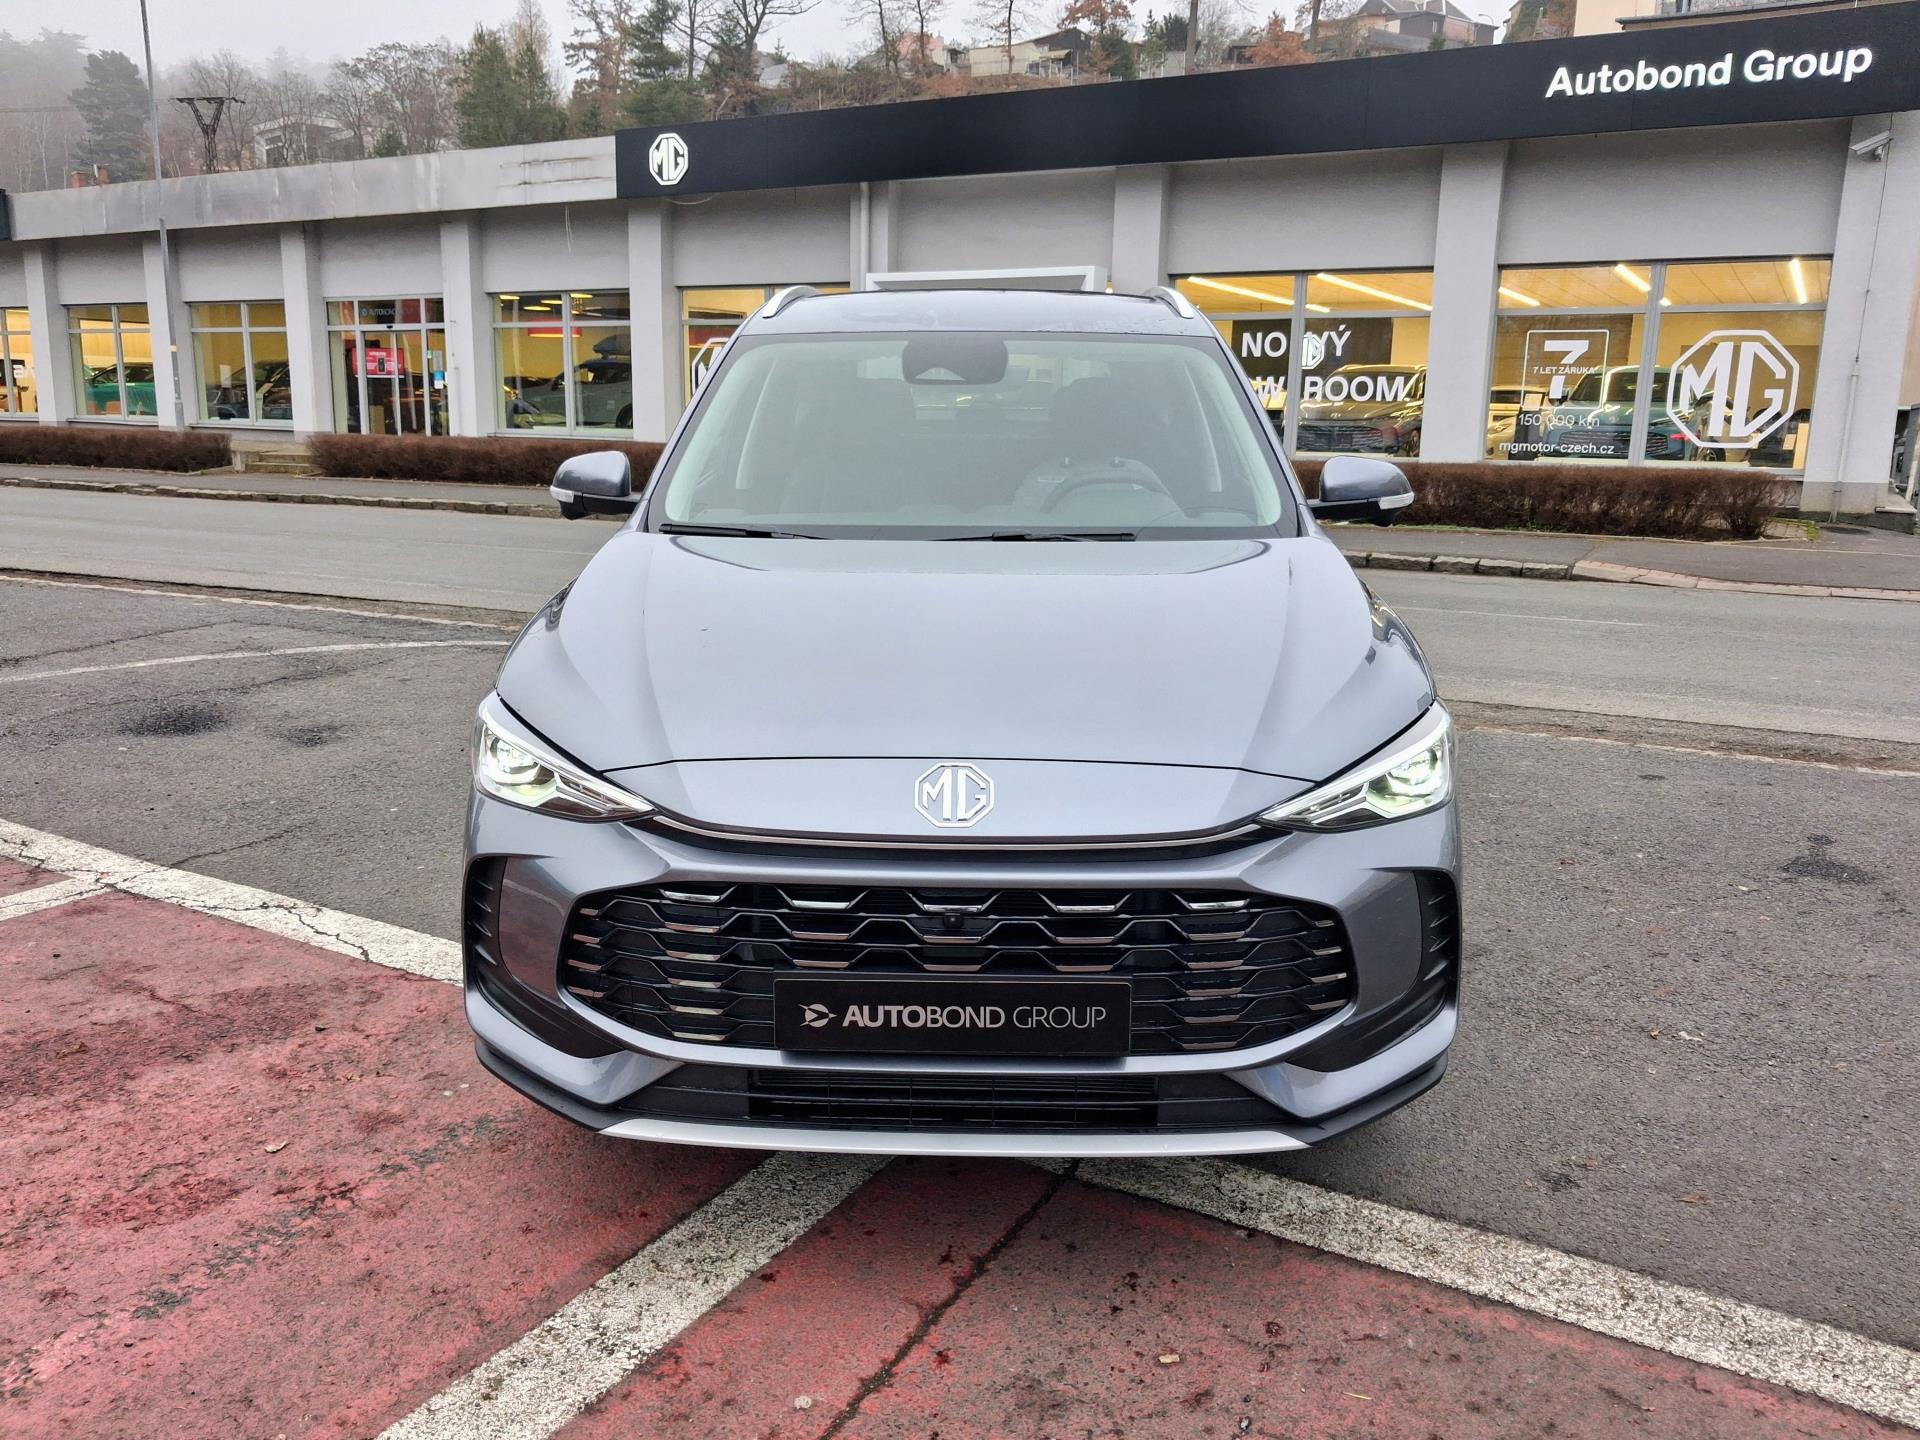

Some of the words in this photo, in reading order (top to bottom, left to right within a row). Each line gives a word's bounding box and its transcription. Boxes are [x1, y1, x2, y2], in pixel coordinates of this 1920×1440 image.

[1545, 53, 1733, 98] Autobond
[1743, 47, 1873, 82] Group
[651, 137, 685, 181] MG
[1533, 366, 1540, 374] 7
[1540, 366, 1557, 374] LET
[1558, 364, 1595, 374] ZÁRUKA
[1679, 341, 1787, 437] MG
[1519, 414, 1541, 426] 150
[1546, 414, 1574, 426] 000
[1578, 414, 1600, 427] km
[1499, 442, 1615, 454] mgmotor-czech.cz
[922, 768, 987, 822] MG
[842, 1004, 1006, 1029] AUTOBOND
[1012, 1005, 1107, 1029] GROUP
